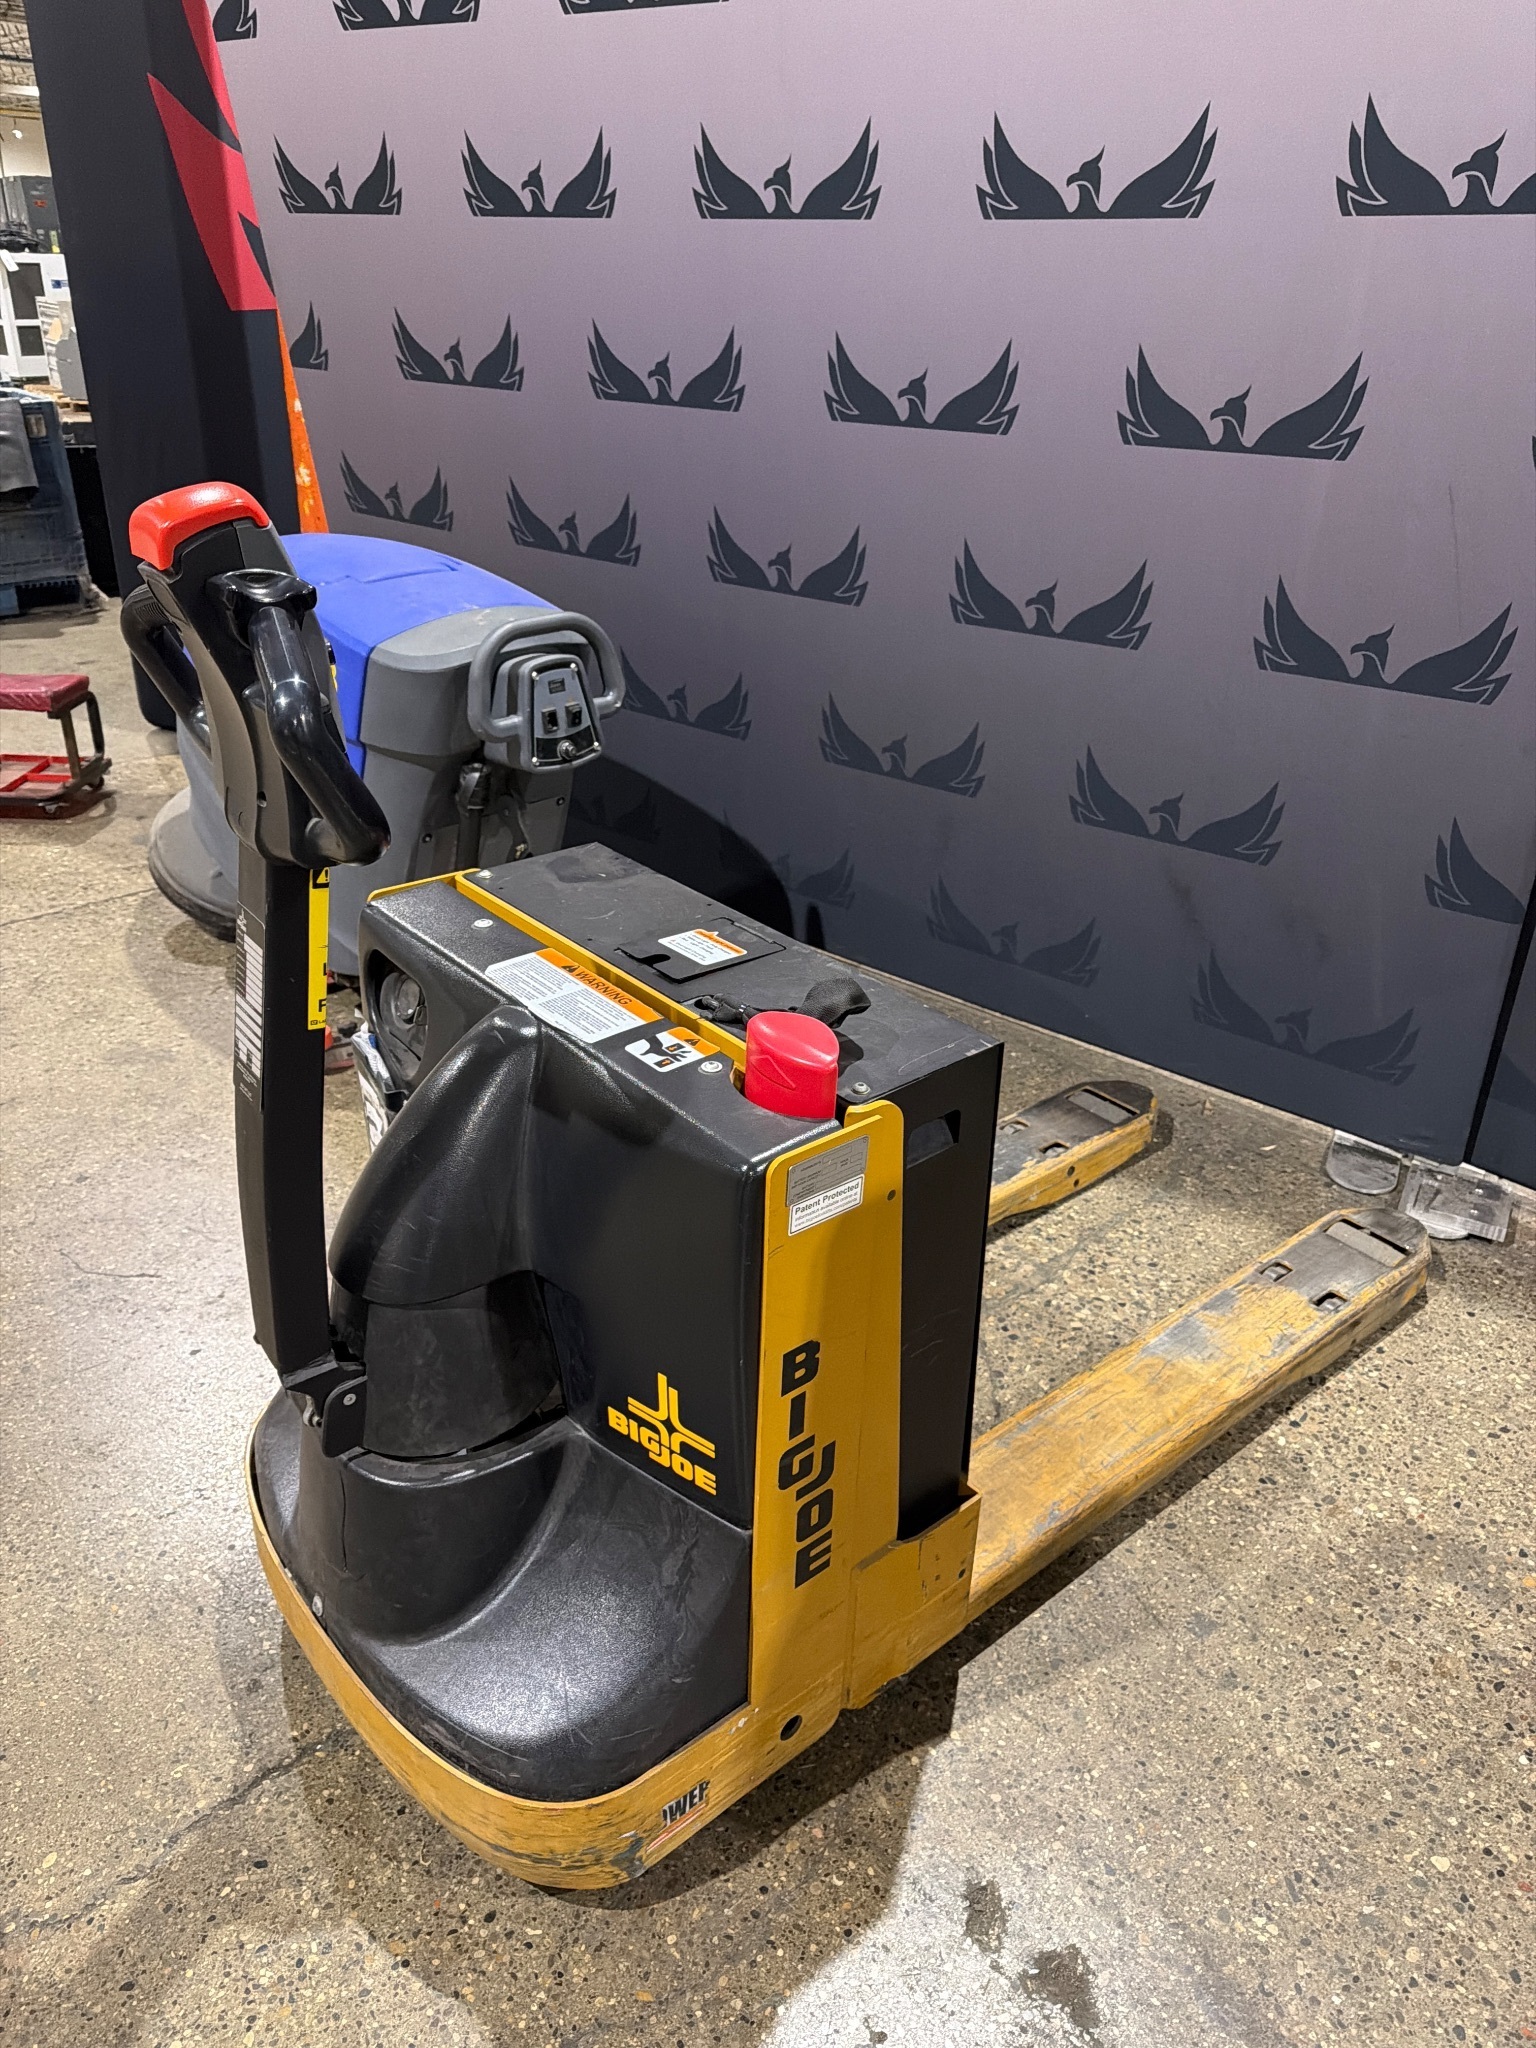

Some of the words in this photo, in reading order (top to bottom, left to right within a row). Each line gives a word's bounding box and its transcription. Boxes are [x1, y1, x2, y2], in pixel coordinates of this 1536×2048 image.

[575, 971, 632, 1005] WARNING
[795, 1199, 821, 1216] Patent
[822, 1181, 860, 1203] Protected
